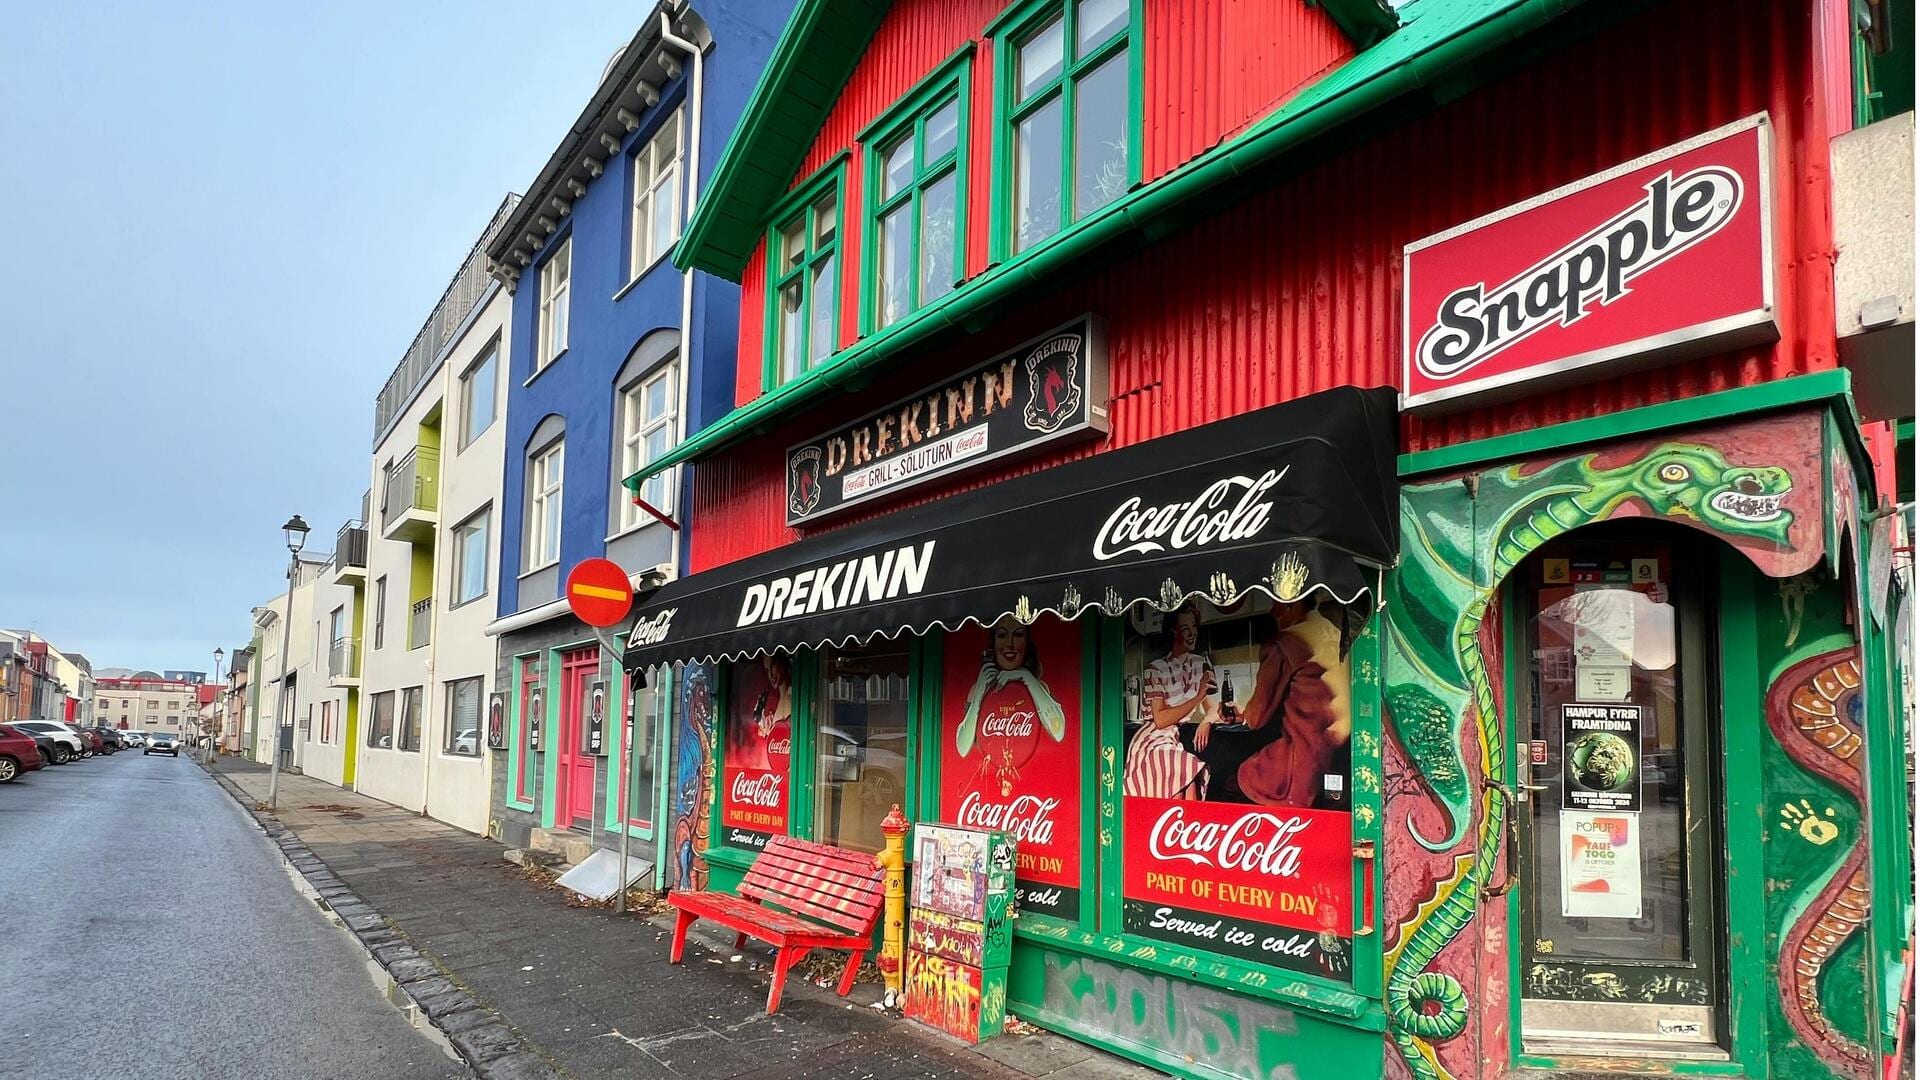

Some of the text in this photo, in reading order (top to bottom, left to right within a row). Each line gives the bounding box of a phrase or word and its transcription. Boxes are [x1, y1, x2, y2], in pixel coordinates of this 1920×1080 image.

[1429, 174, 1716, 367] Snapple
[1028, 338, 1078, 371] DREKINN
[824, 358, 1017, 477] DREKINN
[792, 447, 820, 469] DREKINN
[1093, 464, 1290, 561] Coca-Cola
[736, 540, 936, 628] DREKINN
[627, 607, 679, 649] Coca-Cola
[982, 711, 1035, 737] Coca-Cola
[1565, 707, 1638, 719] HAMPUR FYRIR
[732, 771, 783, 807] Coca-Cola
[730, 809, 784, 827] PART OF EVERY DAY
[957, 791, 1061, 845] Coca-Cola
[1576, 822, 1614, 832] POPUP
[730, 828, 754, 845] Served
[754, 833, 765, 847] ice
[1149, 805, 1314, 878] Coca-Cola
[1016, 852, 1038, 870] ERY
[1040, 856, 1064, 874] DAY
[1028, 887, 1062, 907] cold
[1146, 871, 1319, 917] PART OF EVERY DAY
[1149, 907, 1315, 958] Served ice cold
